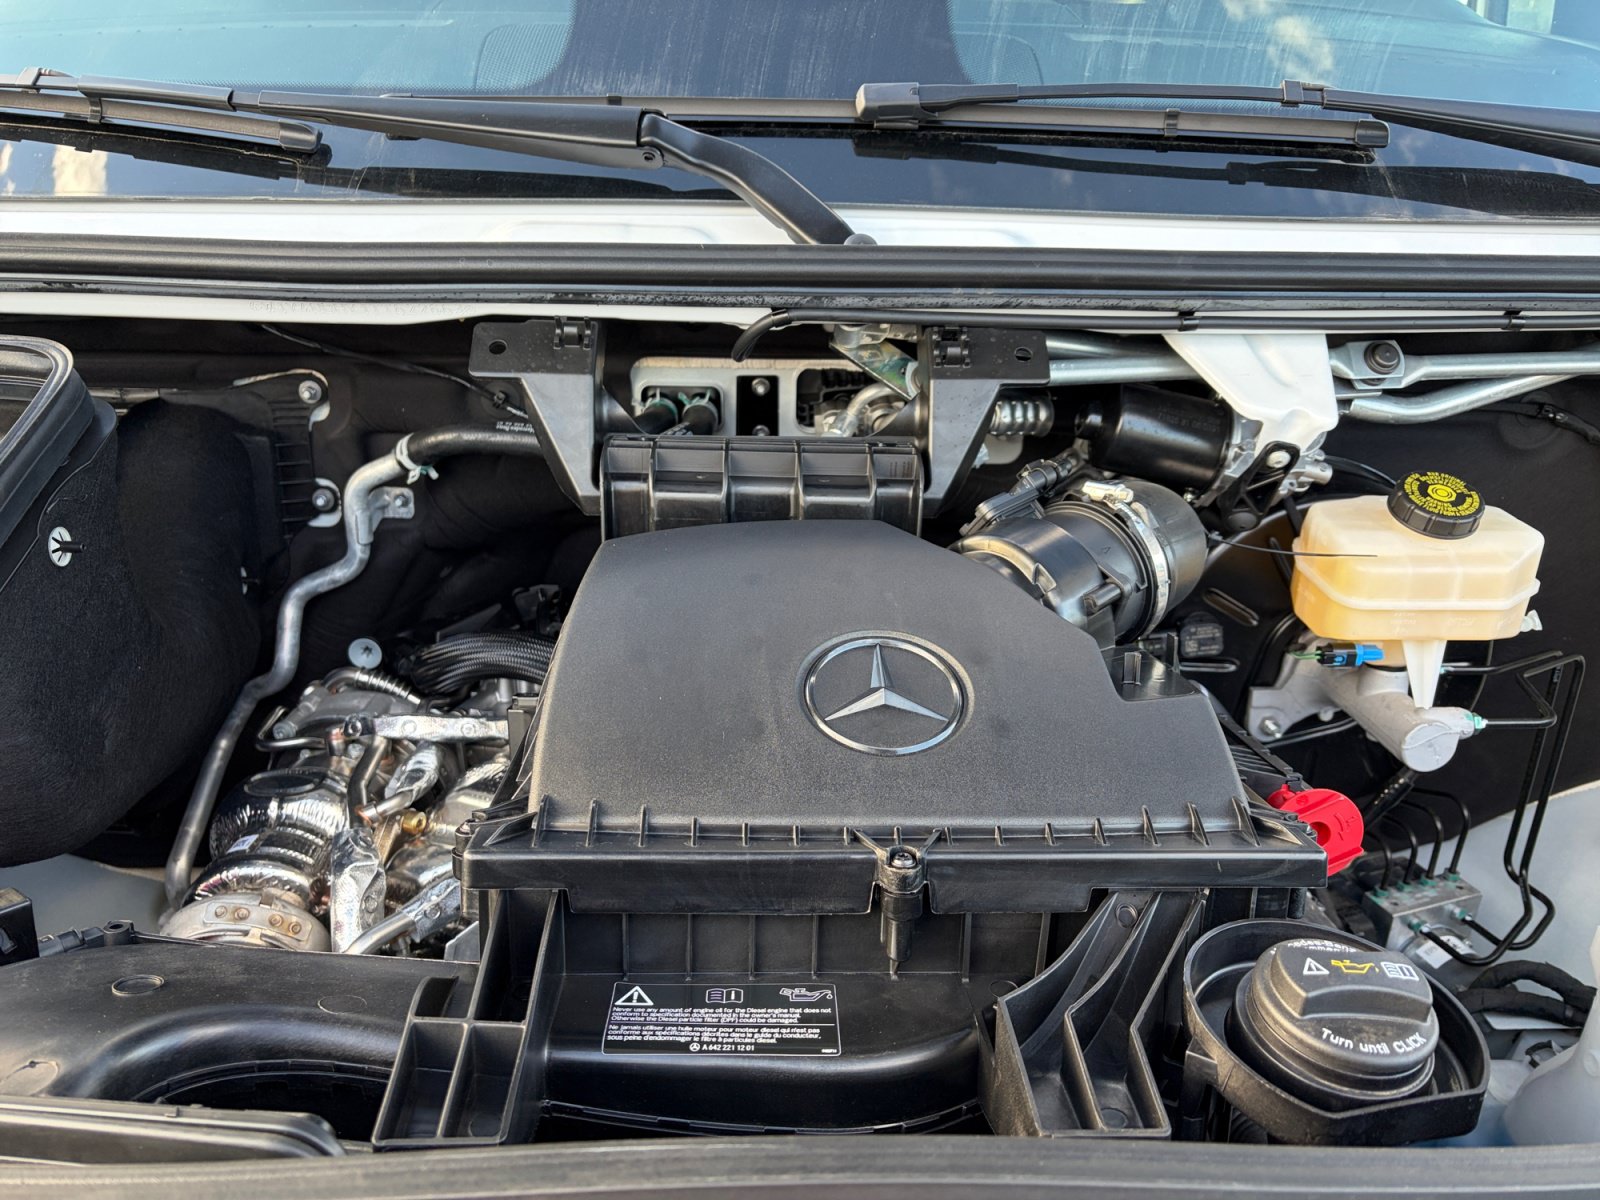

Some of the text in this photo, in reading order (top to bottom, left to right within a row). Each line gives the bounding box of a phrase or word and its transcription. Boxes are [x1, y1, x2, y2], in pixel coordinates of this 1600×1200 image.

[1322, 1028, 1427, 1054] Turn until CLICK
